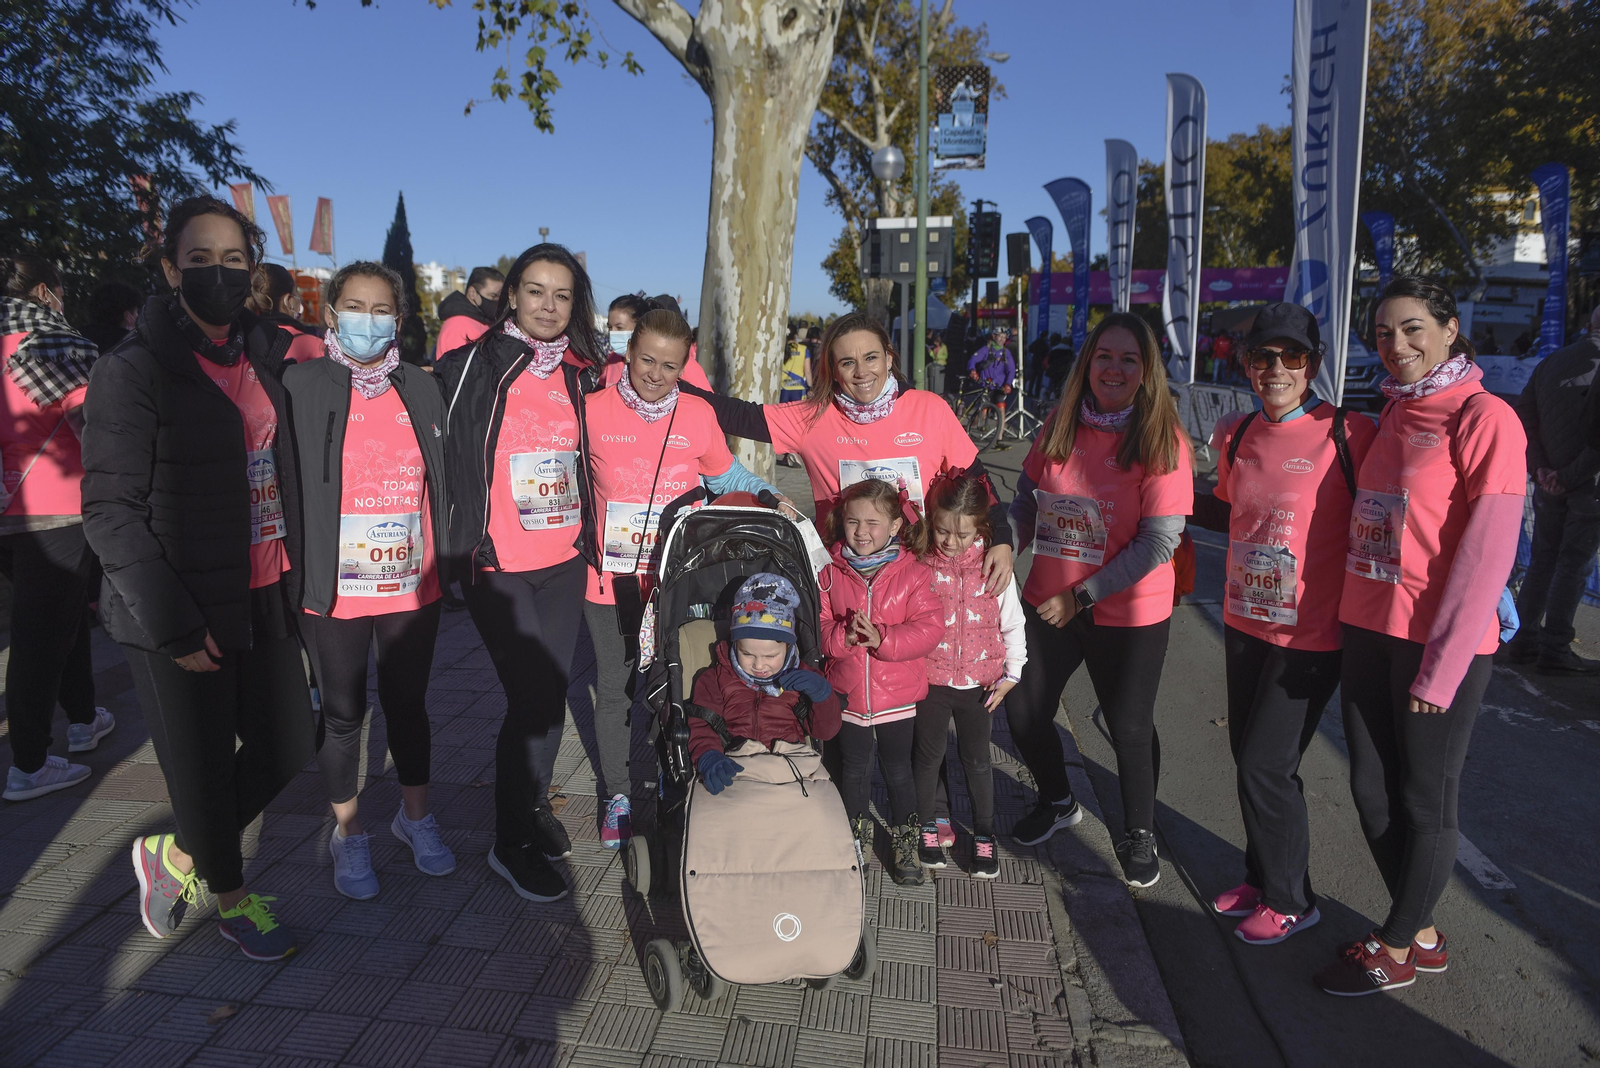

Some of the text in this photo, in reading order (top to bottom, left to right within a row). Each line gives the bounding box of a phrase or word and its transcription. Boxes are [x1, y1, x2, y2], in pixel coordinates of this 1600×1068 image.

[552, 436, 574, 448] POR
[602, 434, 637, 443] OYSHO
[836, 436, 868, 446] OYSHO
[399, 466, 421, 477] POR
[382, 480, 419, 492] TODAS
[538, 481, 566, 497] 016
[664, 482, 687, 491] POR
[250, 485, 277, 505] 016
[354, 496, 419, 508] NOSOTRAS
[1098, 500, 1115, 511] OR
[1271, 508, 1295, 522] POR
[1057, 517, 1085, 532] 016
[1257, 520, 1292, 535] TODAS
[370, 530, 407, 538] ASTURIANA
[1238, 530, 1290, 549] NOSOTRAS
[1357, 524, 1383, 543] 016
[370, 546, 407, 563] 016
[1037, 544, 1058, 553] OYSHO
[381, 565, 396, 573] 839
[606, 560, 633, 568] OYSHO
[1244, 572, 1273, 590] 016
[1252, 590, 1264, 598] 845
[1230, 603, 1248, 612] OYSHO
